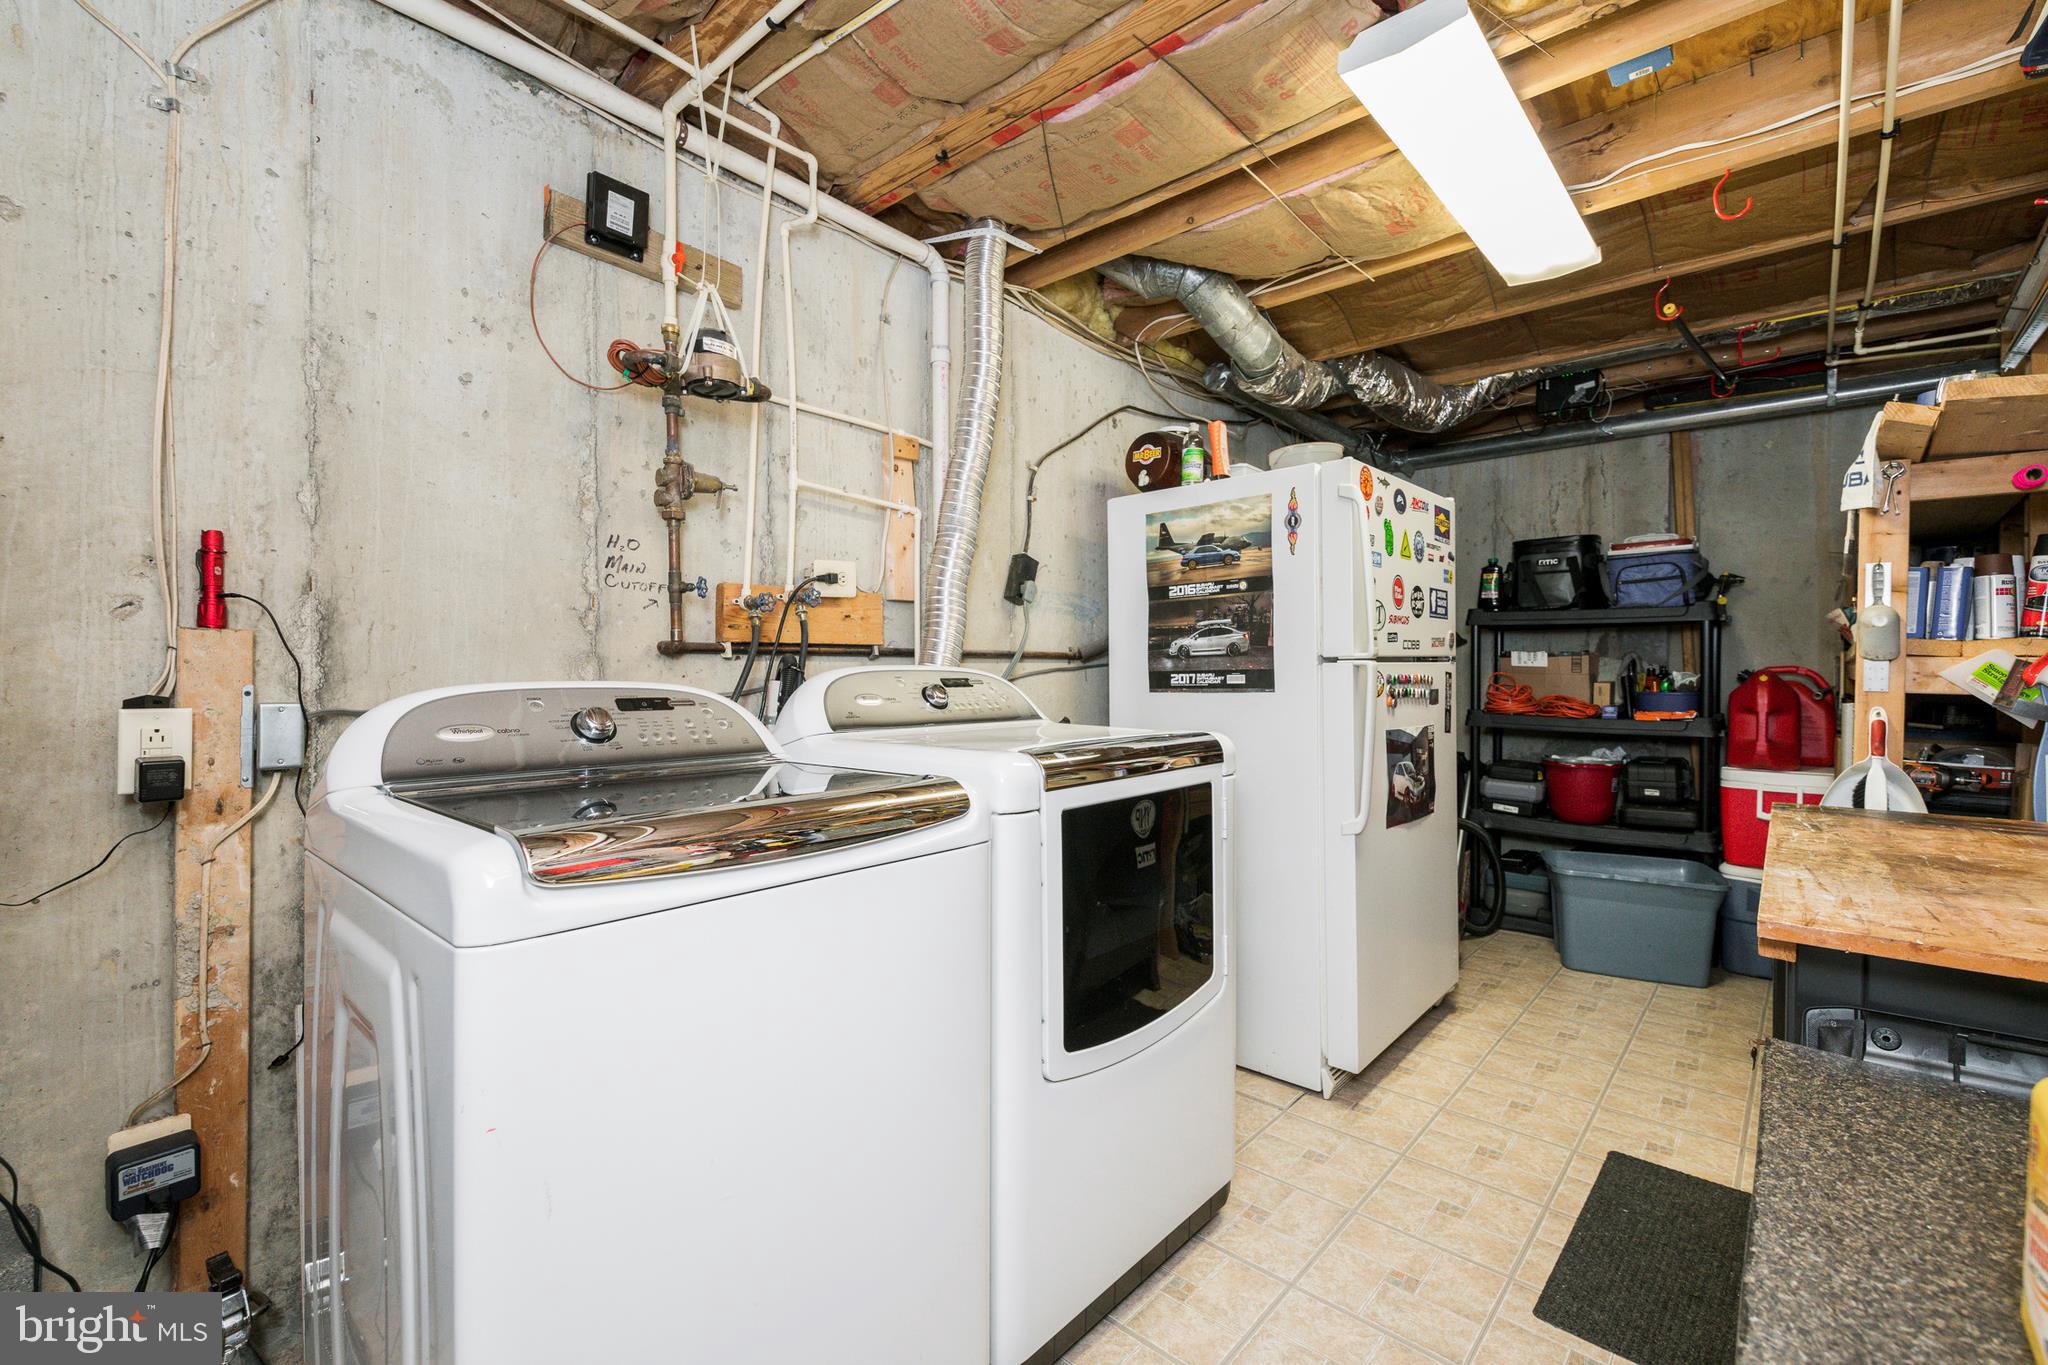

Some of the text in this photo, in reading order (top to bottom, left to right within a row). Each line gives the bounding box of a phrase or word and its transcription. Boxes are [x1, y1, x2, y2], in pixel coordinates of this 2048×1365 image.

[1168, 583, 1196, 597] 2016
[1170, 673, 1196, 684] 2017
[450, 727, 484, 736] Whirlpool
[122, 1163, 175, 1187] WATCHDOG
